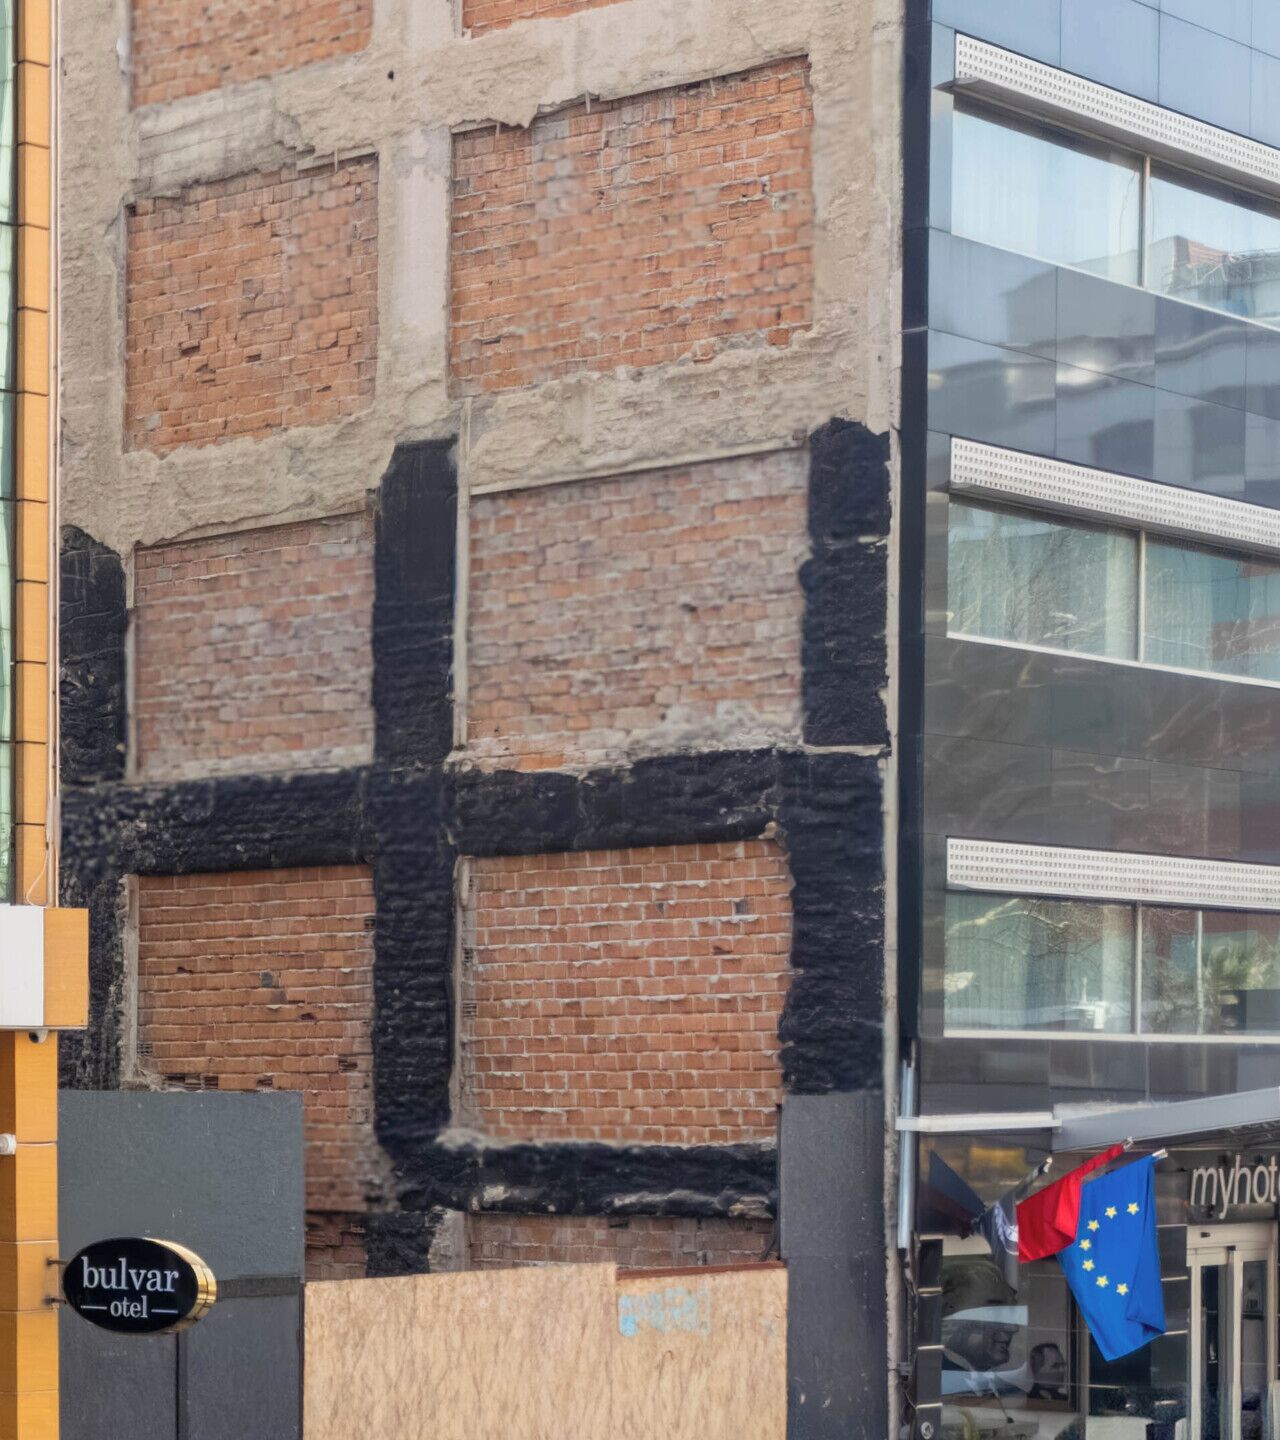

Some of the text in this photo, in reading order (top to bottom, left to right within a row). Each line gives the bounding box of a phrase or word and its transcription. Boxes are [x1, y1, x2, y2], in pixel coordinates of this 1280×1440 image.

[1190, 1152, 1280, 1220] myhot
[80, 1256, 179, 1292] bulvar
[110, 1295, 148, 1318] otel
